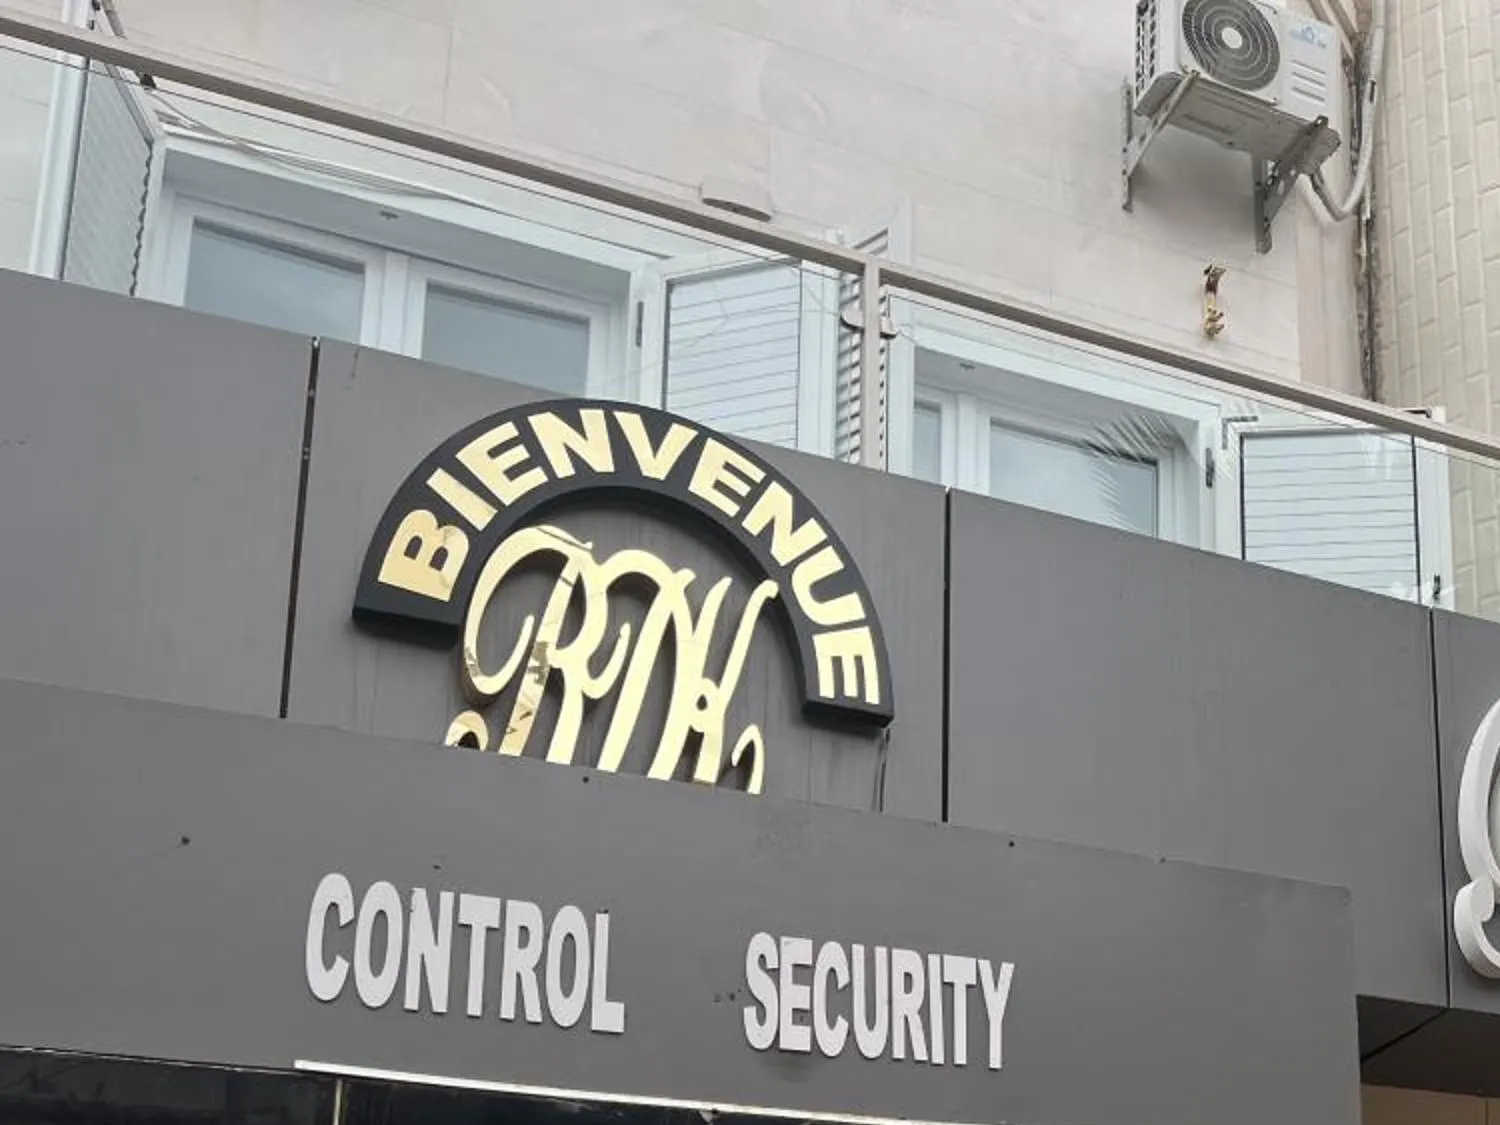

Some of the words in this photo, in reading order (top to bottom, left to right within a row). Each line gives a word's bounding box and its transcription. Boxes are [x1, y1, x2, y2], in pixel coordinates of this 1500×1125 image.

[378, 408, 880, 705] BIENVENUE
[306, 873, 625, 1033] CONTROL
[743, 931, 1015, 1069] SECURITY
